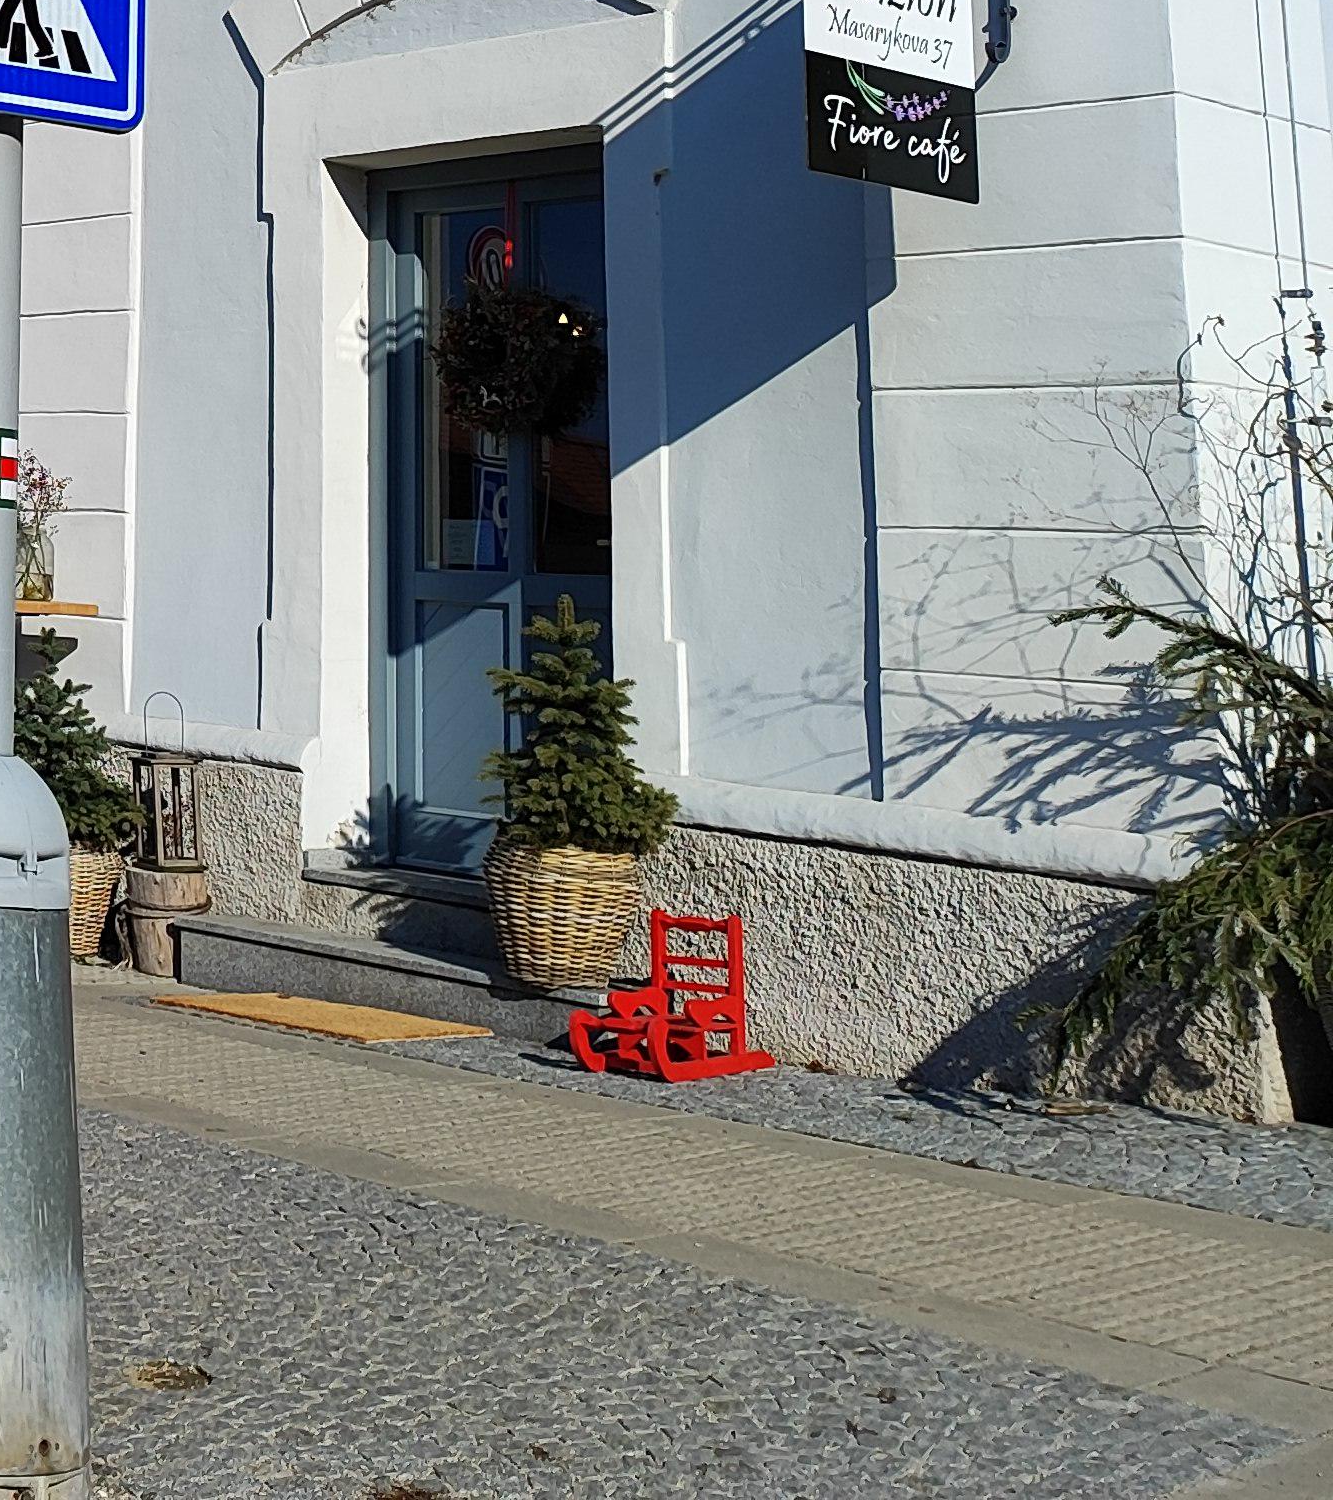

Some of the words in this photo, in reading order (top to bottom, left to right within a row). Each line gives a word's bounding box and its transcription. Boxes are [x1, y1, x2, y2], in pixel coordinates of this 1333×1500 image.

[826, 3, 930, 62] Masarykova
[930, 37, 954, 70] 37
[823, 94, 901, 152] Fiore
[907, 116, 967, 184] café
